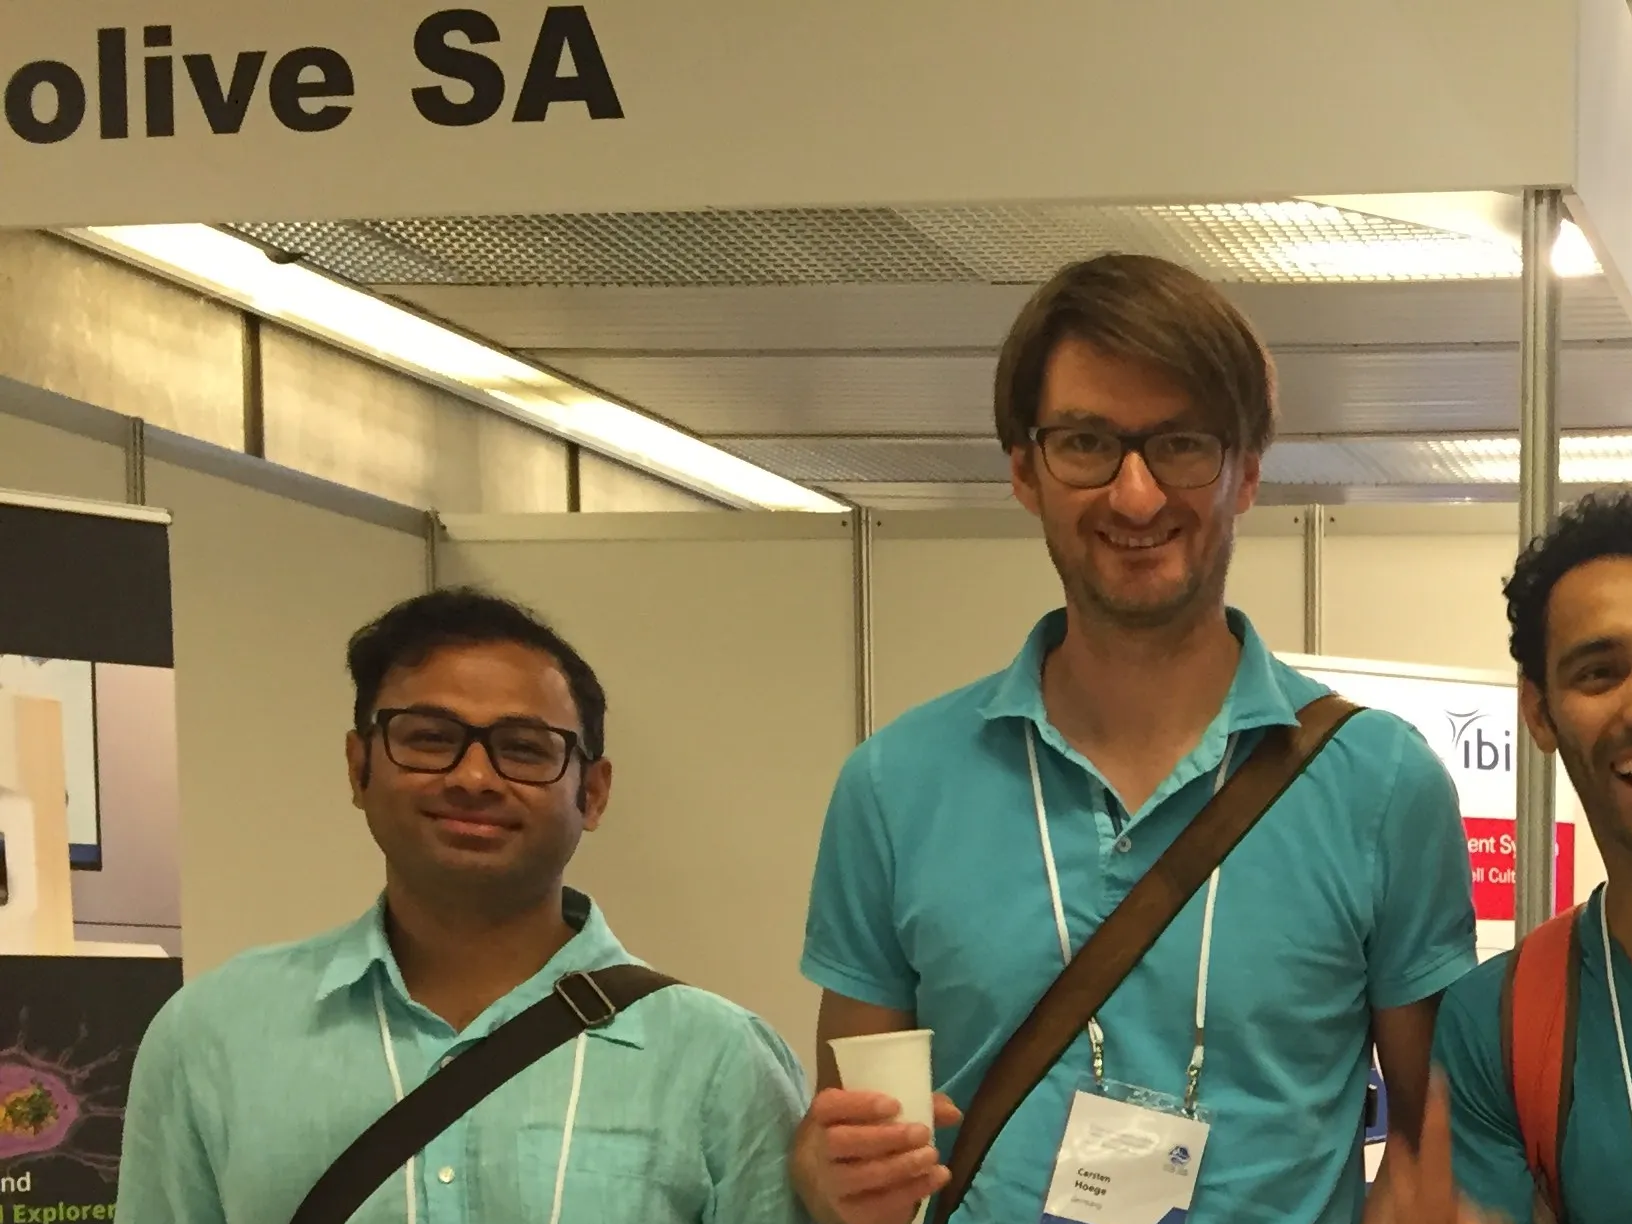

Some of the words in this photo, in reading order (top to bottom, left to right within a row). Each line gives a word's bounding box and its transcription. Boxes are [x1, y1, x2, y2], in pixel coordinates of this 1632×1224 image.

[4, 25, 355, 144] olive
[411, 5, 626, 127] SA
[1467, 836, 1496, 854] ent
